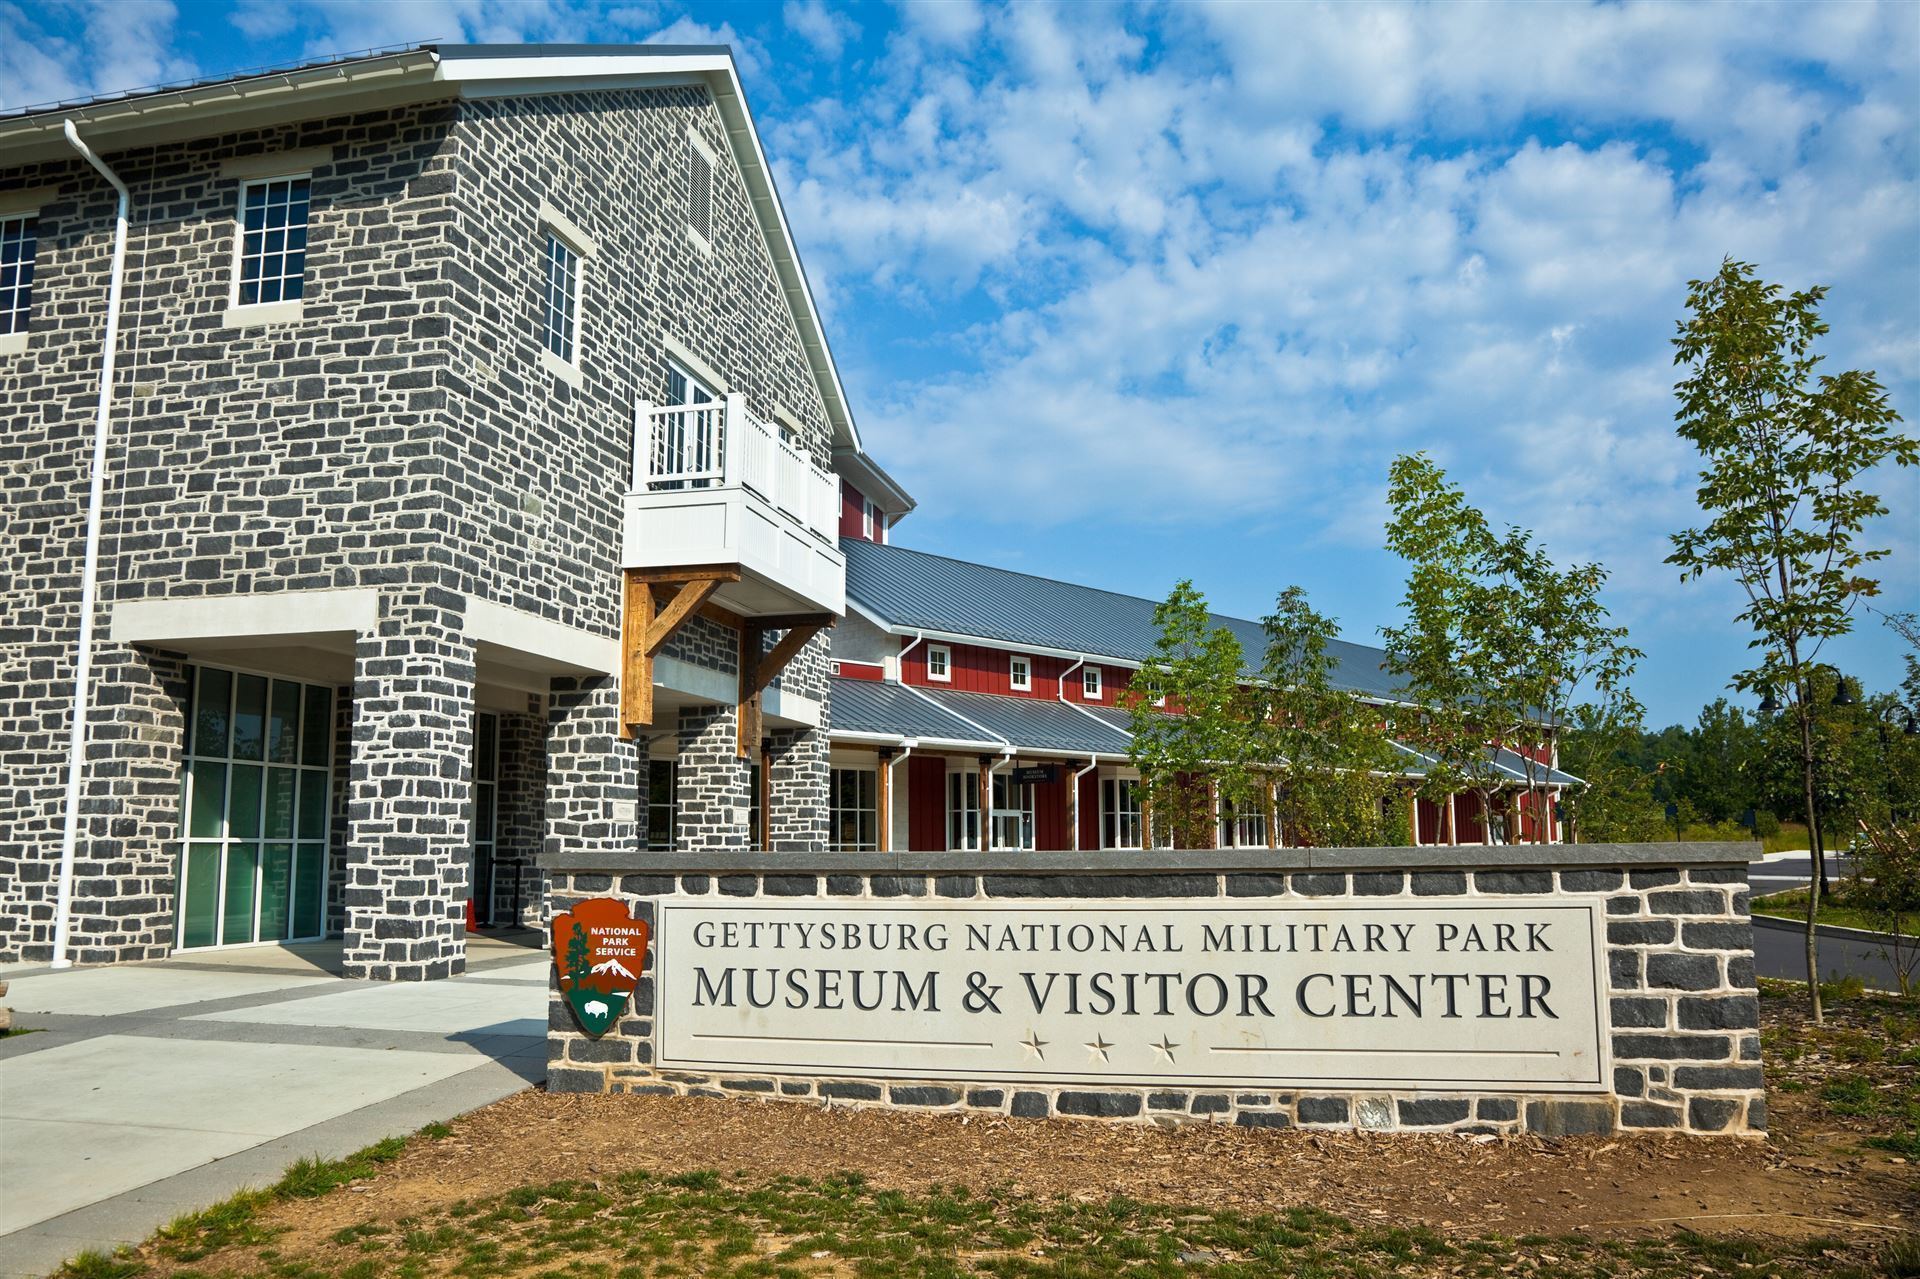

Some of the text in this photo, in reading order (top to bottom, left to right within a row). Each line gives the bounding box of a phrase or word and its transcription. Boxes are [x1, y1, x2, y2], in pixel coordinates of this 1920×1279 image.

[590, 927, 641, 936] NATIONAL
[693, 921, 1554, 953] GETTYSBURG NATIONAL MILITARY PARK
[602, 938, 629, 946] PARK
[595, 948, 636, 957] SERVICE
[692, 967, 1560, 1019] MUSEUM & VISITOR CENTER
